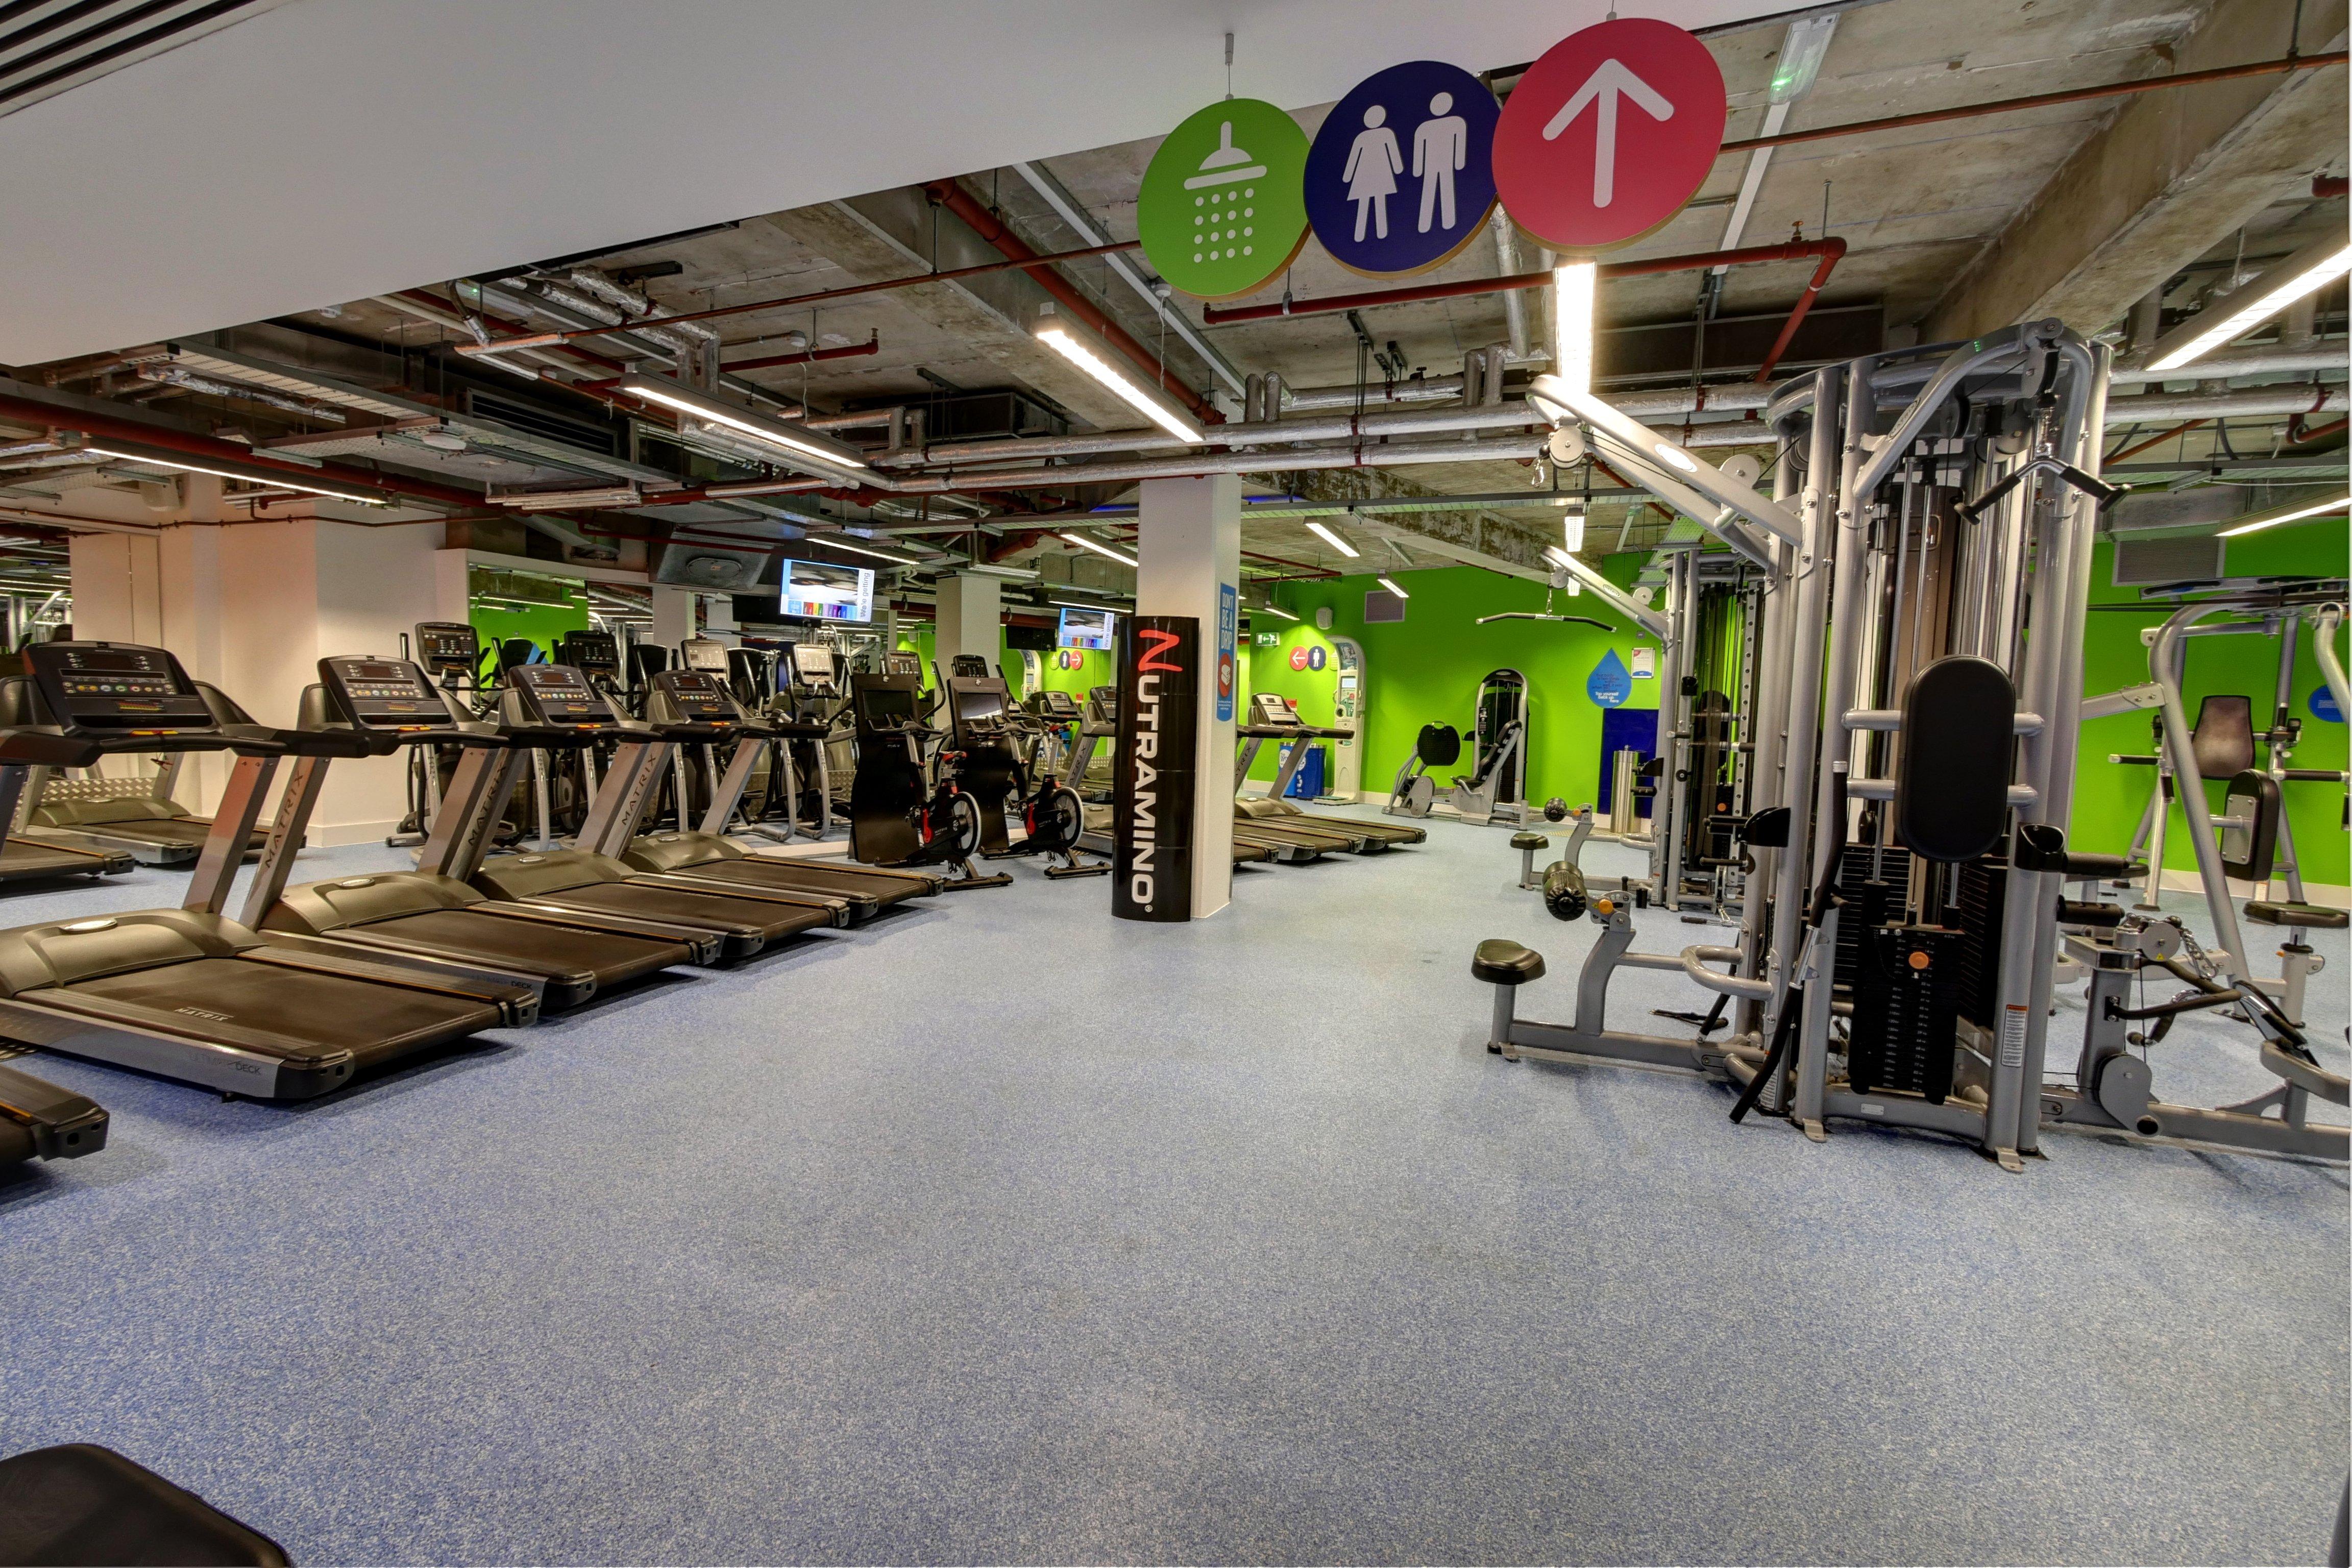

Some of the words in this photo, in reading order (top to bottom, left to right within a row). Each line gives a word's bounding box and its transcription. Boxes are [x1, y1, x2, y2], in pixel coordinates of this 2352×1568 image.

[1222, 592, 1234, 610] DON'T
[1221, 608, 1229, 629] BE
[1229, 610, 1233, 630] A
[1221, 629, 1233, 650] DRIP
[1069, 745, 1086, 787] ATRIX
[1235, 745, 1252, 776] TRIX
[623, 754, 656, 825] MATRIX
[468, 763, 506, 846] MATRIX
[265, 770, 303, 868] MATRIX
[511, 980, 533, 990] DECK
[173, 1008, 229, 1021] MATRIX
[235, 1061, 261, 1075] DECK
